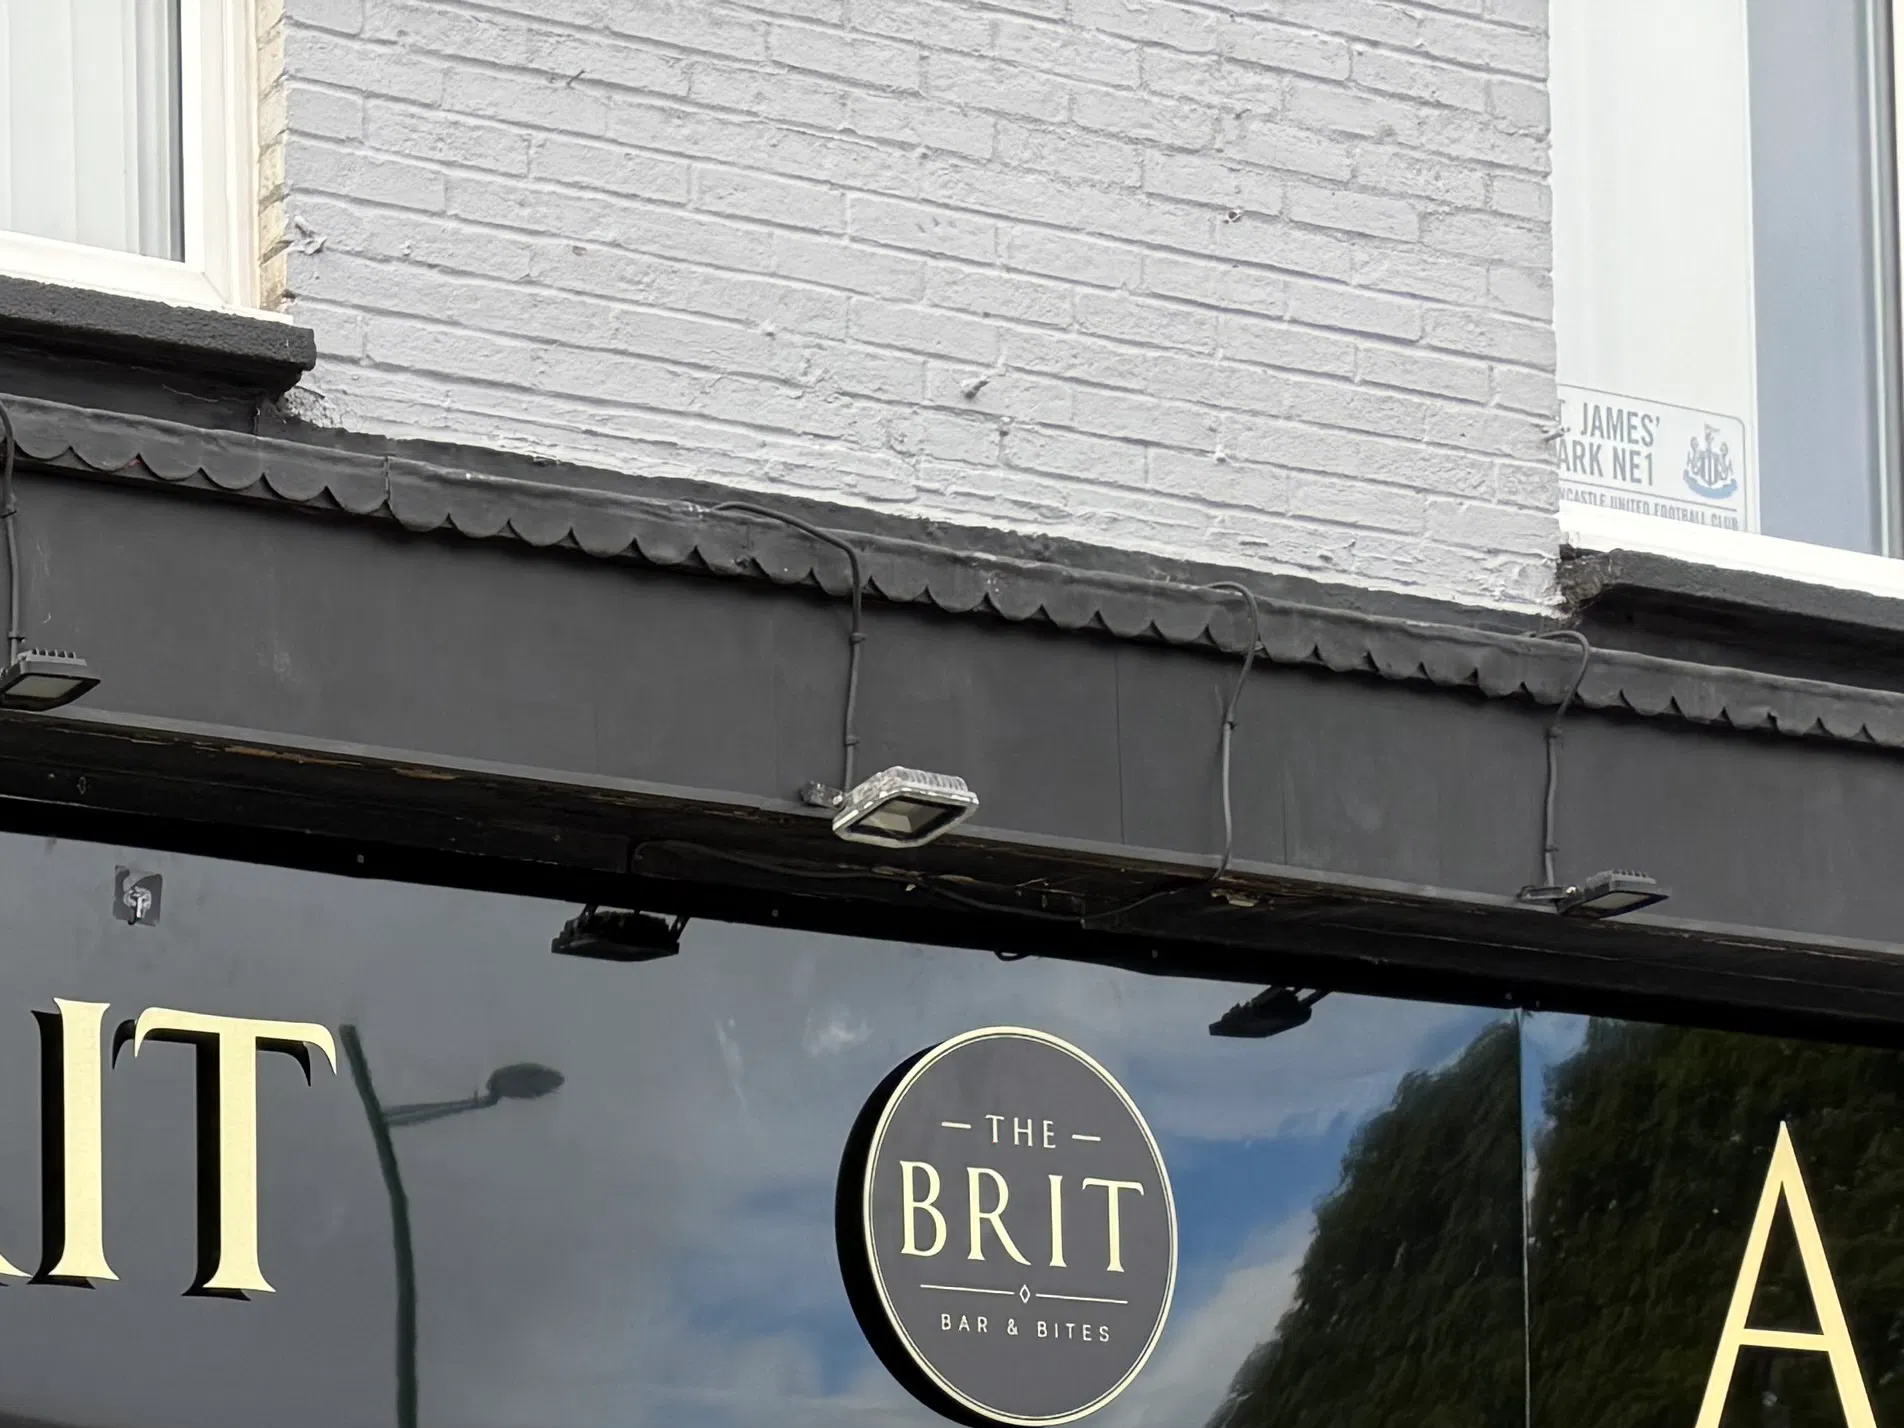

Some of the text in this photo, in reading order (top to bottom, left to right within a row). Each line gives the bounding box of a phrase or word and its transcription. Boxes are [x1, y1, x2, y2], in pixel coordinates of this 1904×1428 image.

[1580, 402, 1660, 448] JAMES'
[1558, 438, 1653, 486] ARK NE1
[985, 1114, 1056, 1148] THE
[899, 1160, 1144, 1272] BRIT
[941, 1313, 1110, 1342] BAR & BITES
